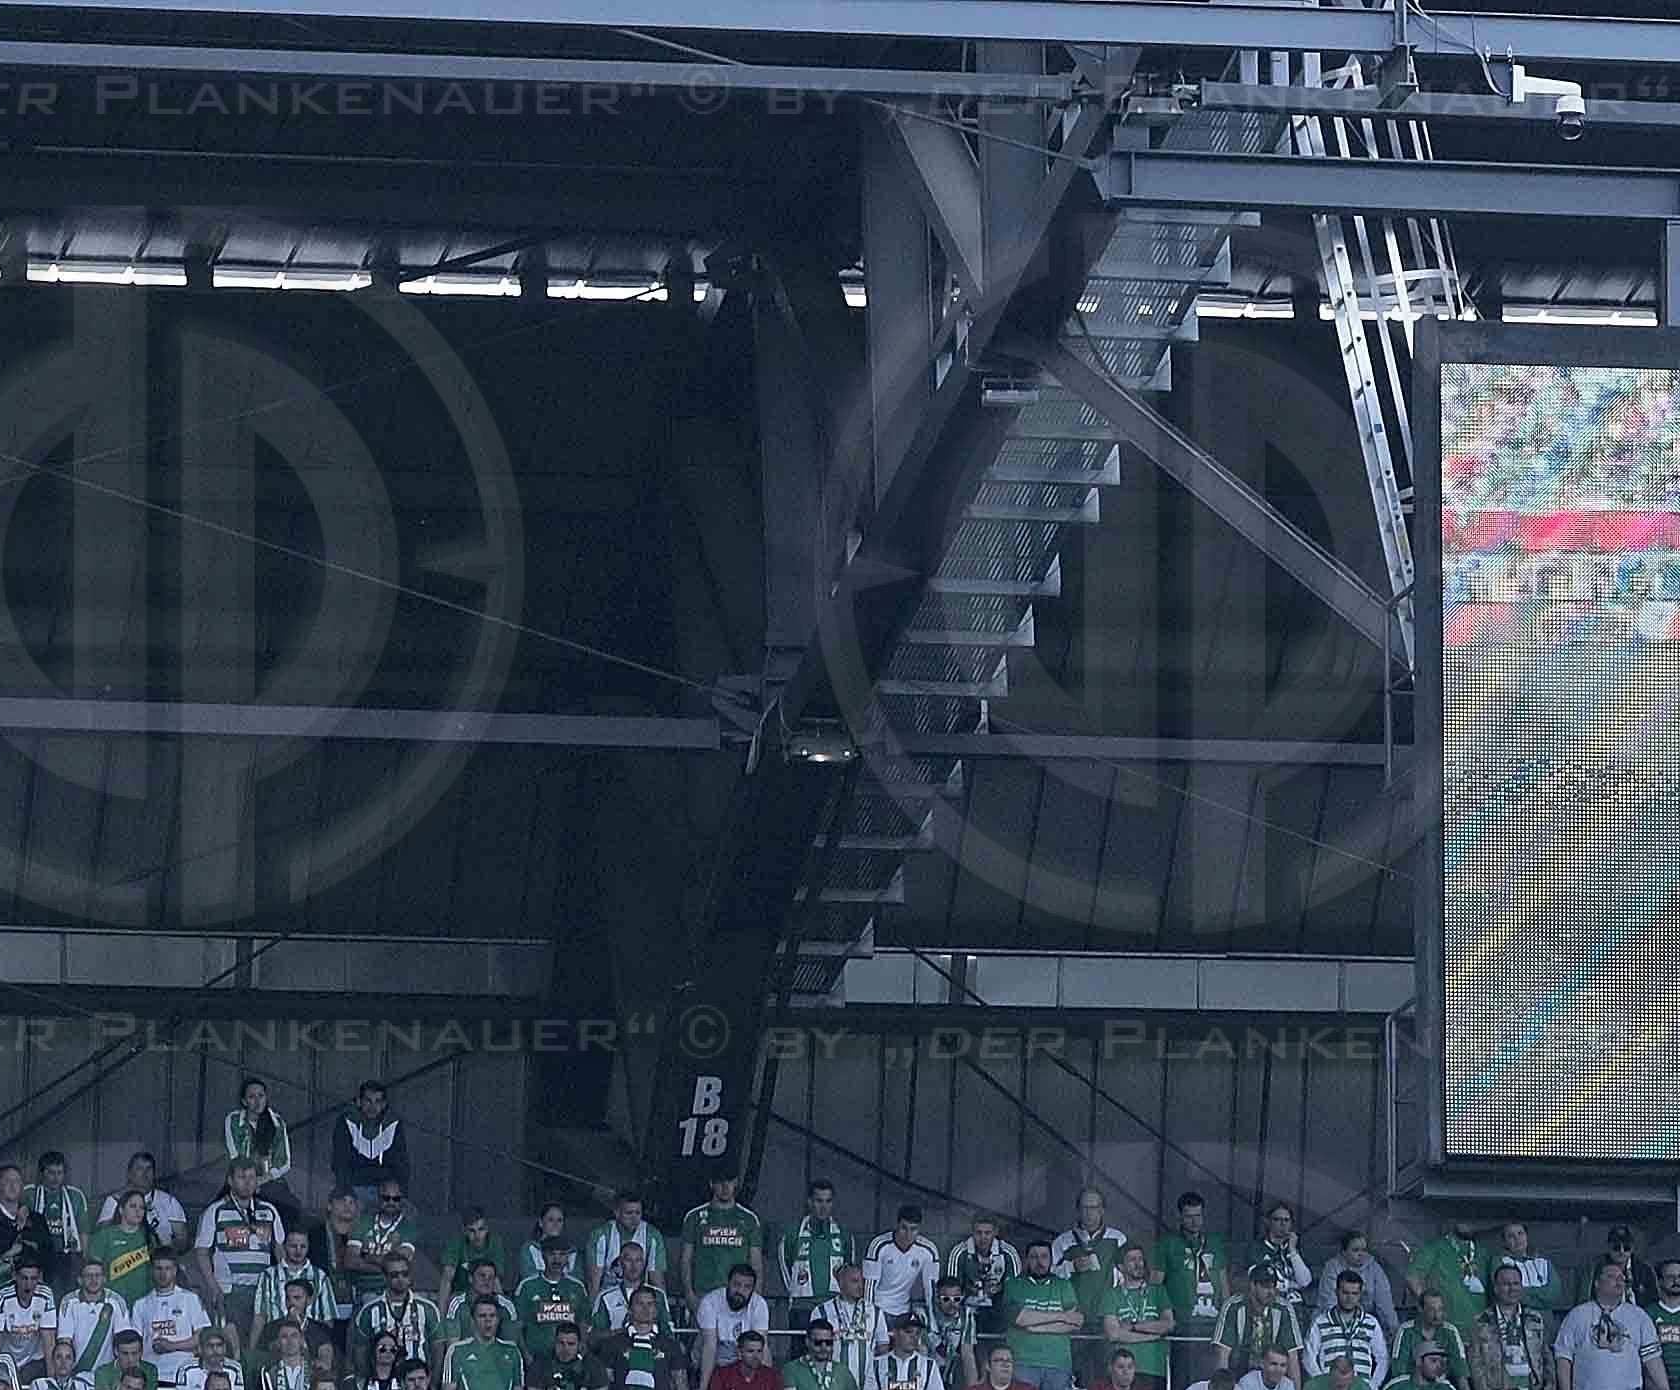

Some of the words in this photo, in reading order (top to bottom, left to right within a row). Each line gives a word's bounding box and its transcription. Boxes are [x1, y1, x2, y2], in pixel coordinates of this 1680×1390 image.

[693, 1076, 724, 1115] B
[679, 1118, 729, 1157] 18
[710, 1228, 736, 1236] WIEN
[544, 1304, 570, 1312] WIEN
